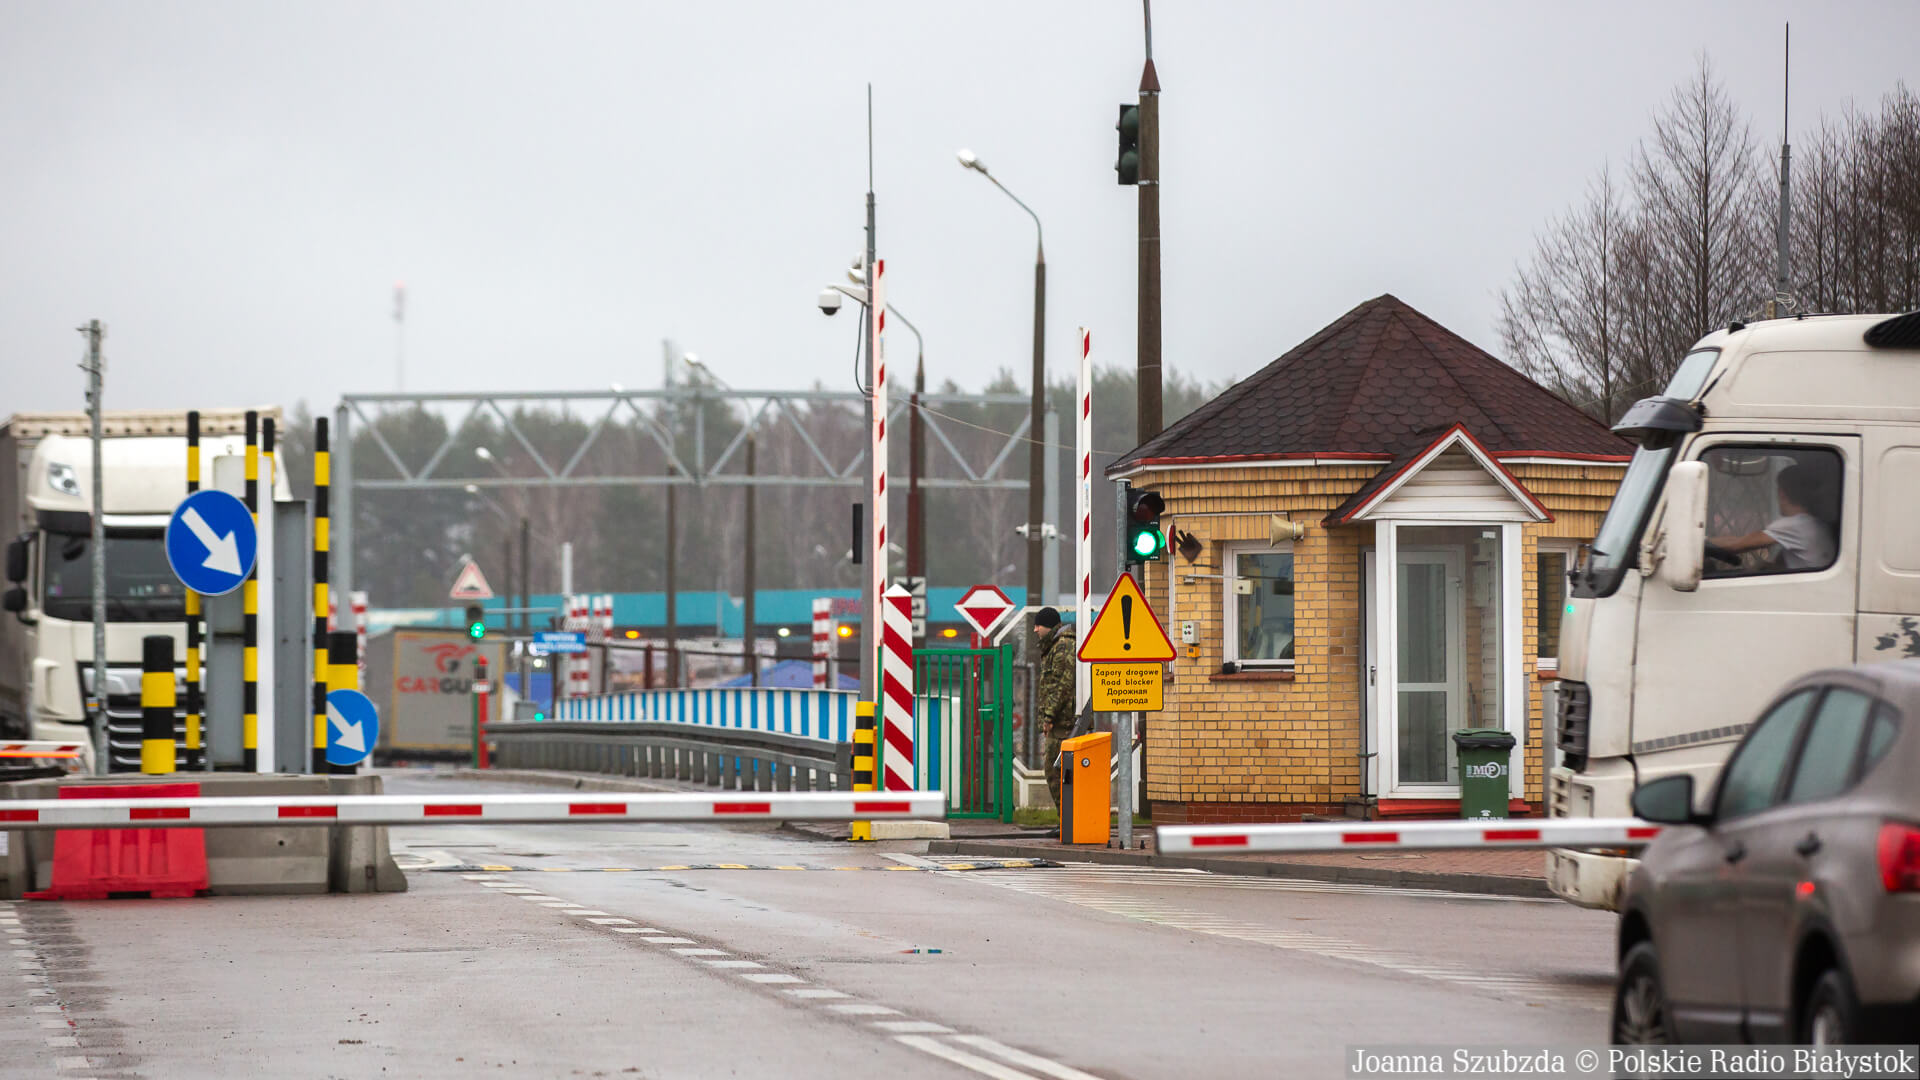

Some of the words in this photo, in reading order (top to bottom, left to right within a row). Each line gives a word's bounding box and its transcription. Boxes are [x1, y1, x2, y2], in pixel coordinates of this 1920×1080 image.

[1095, 668, 1122, 677] Zapory
[1125, 668, 1159, 677] drogowe
[1101, 678, 1121, 686] Road
[1125, 678, 1154, 686] blocker
[1107, 688, 1148, 696] Дорожная
